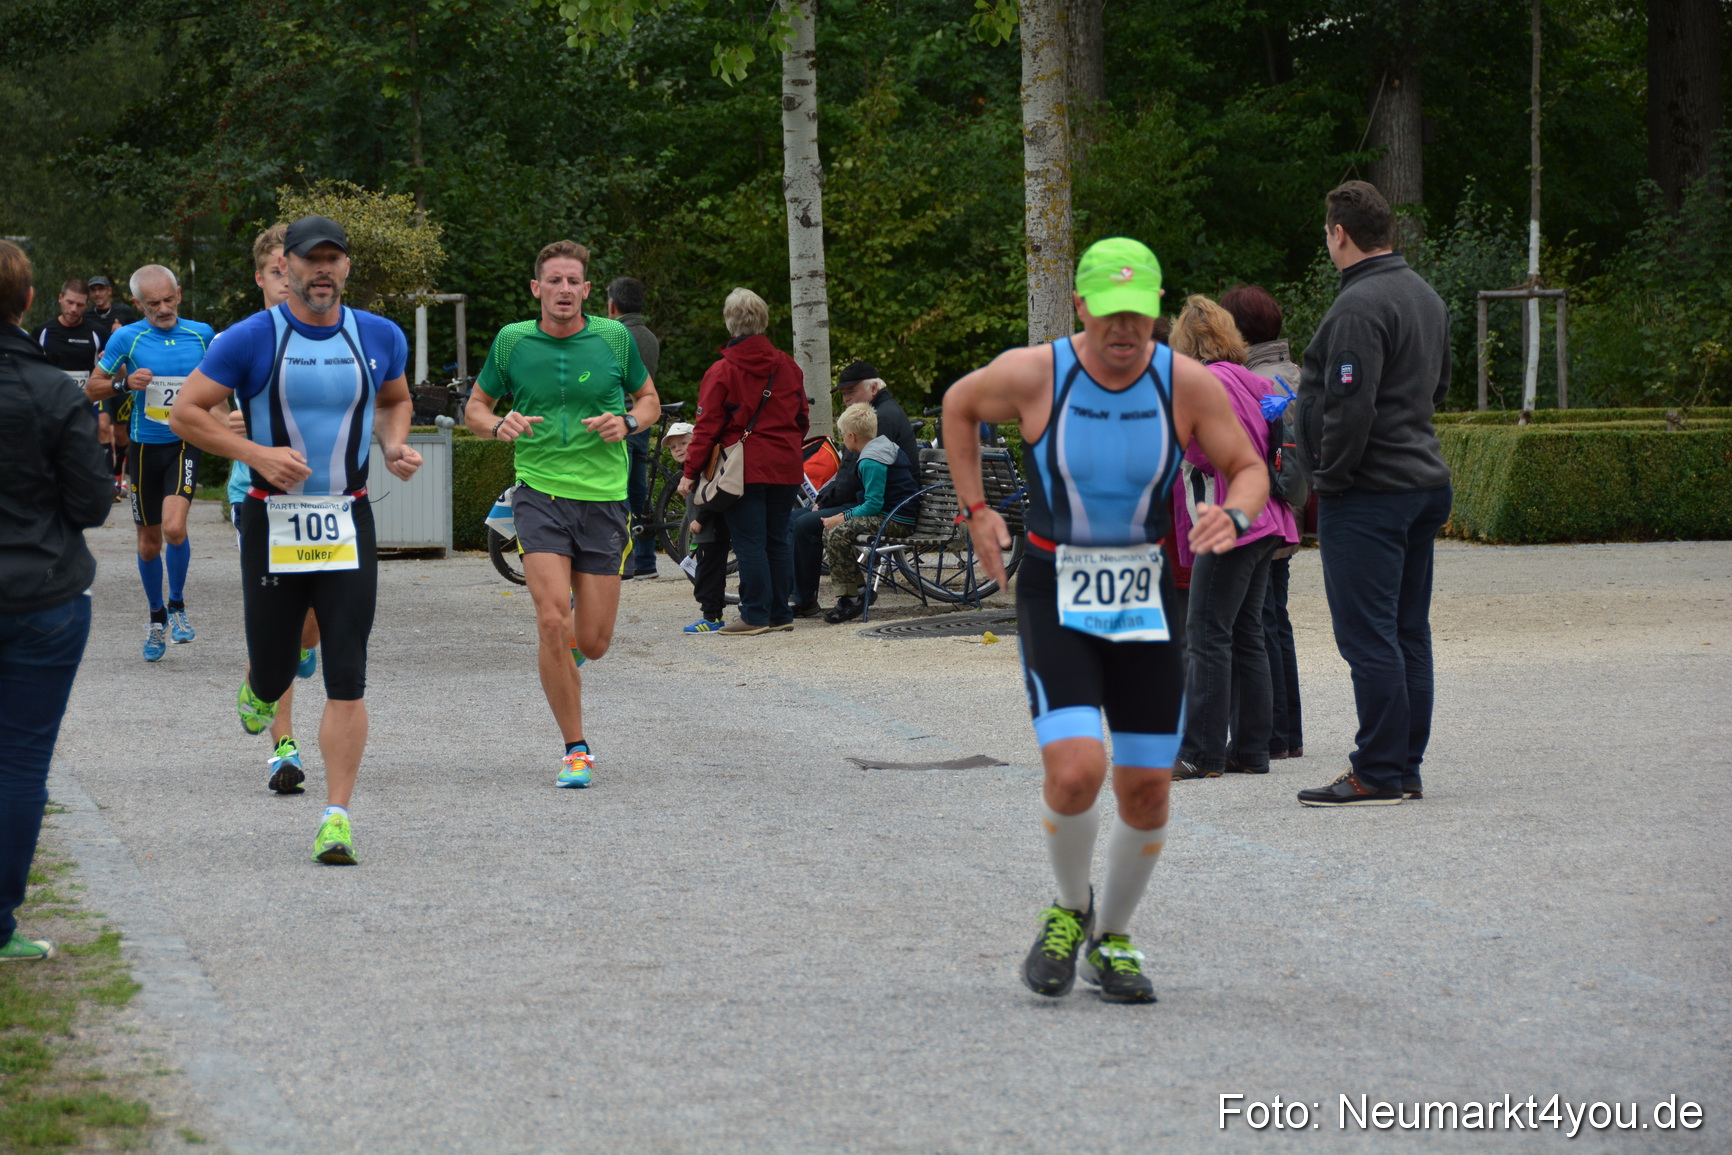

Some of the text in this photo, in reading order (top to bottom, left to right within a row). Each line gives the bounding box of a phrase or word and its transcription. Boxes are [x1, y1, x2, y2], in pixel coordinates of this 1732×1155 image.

[163, 388, 180, 406] 2
[269, 502, 340, 511] PARTL Neumarkt
[288, 512, 340, 542] 109
[296, 549, 333, 561] Volker
[1071, 567, 1151, 606] 2029
